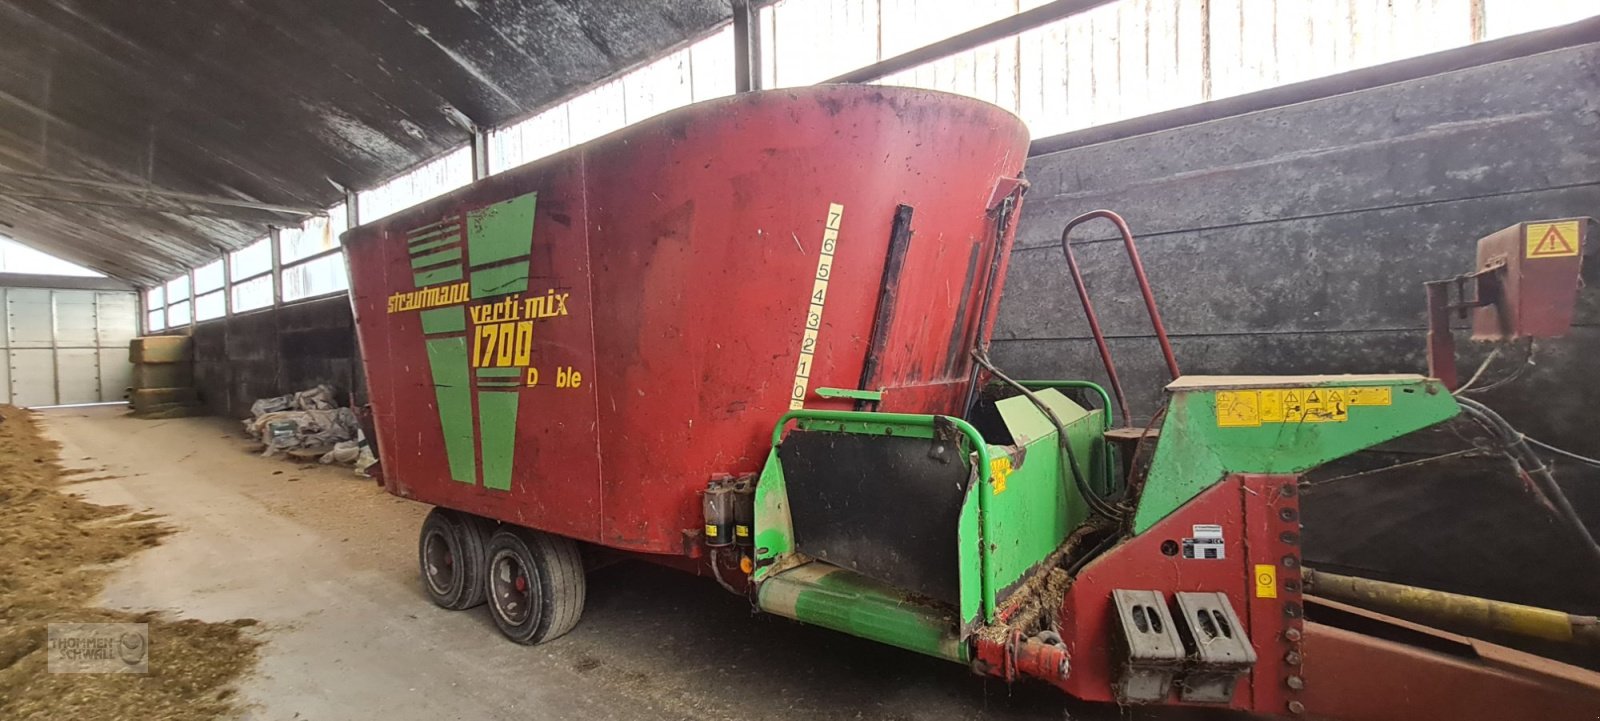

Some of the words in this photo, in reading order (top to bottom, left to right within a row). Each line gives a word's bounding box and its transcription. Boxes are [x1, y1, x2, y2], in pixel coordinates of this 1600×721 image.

[830, 212, 840, 226] 7
[823, 238, 835, 252] 6
[818, 263, 829, 278] 5
[387, 282, 470, 313] strautmann
[813, 288, 823, 303] 4
[469, 289, 569, 325] verti-mix
[808, 313, 819, 327] 3
[472, 320, 534, 367] 1700
[803, 337, 814, 352] 2
[800, 361, 807, 375] 1
[793, 385, 804, 398] 0
